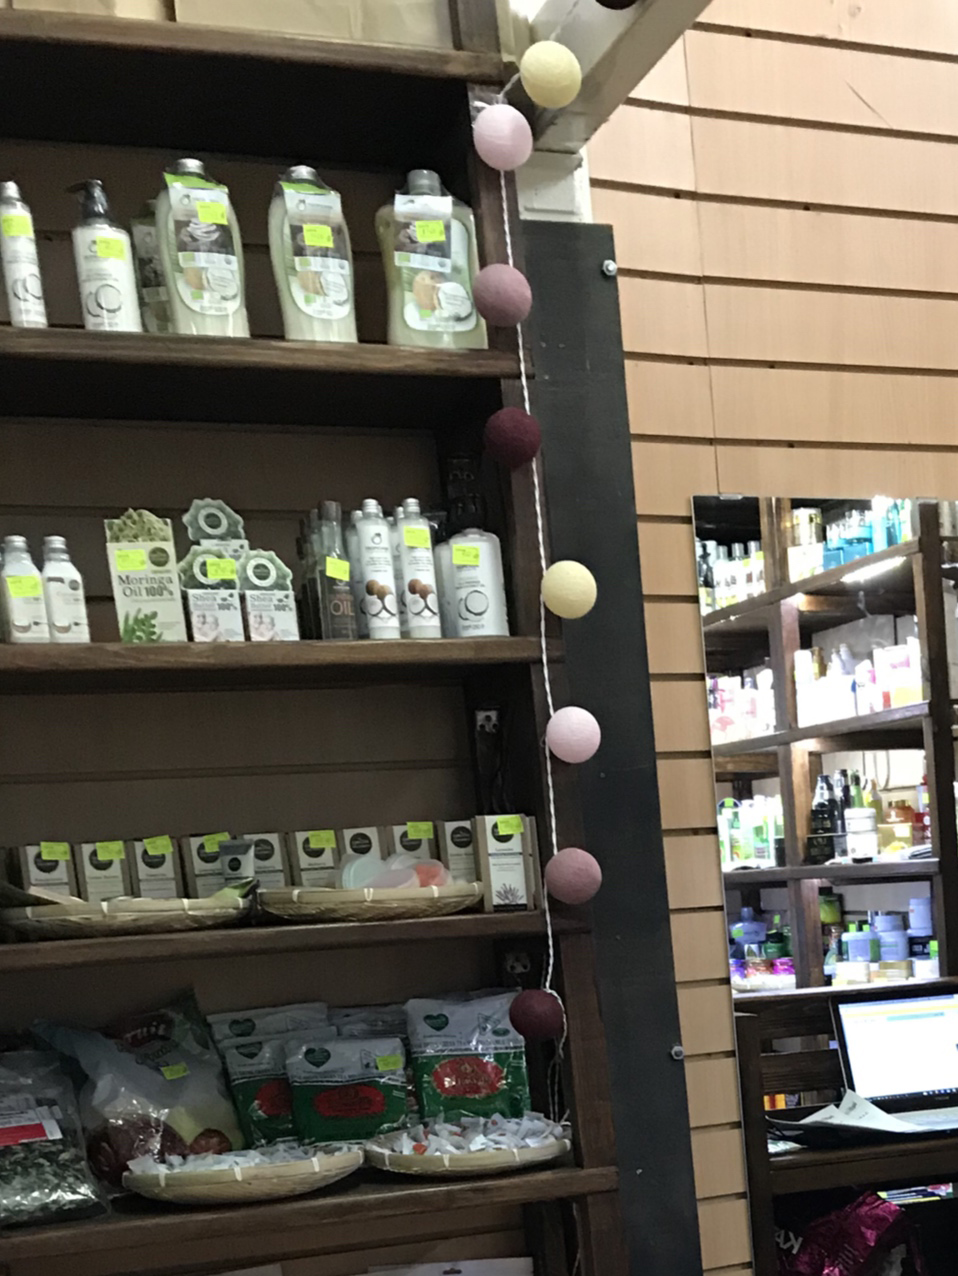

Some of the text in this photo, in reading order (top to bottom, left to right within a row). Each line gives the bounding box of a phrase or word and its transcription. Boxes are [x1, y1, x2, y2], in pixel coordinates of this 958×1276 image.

[117, 574, 174, 588] Moringa
[123, 584, 174, 598] Oil 100%
[192, 593, 216, 602] Shea
[250, 593, 274, 602] Shea
[329, 600, 355, 616] OIL
